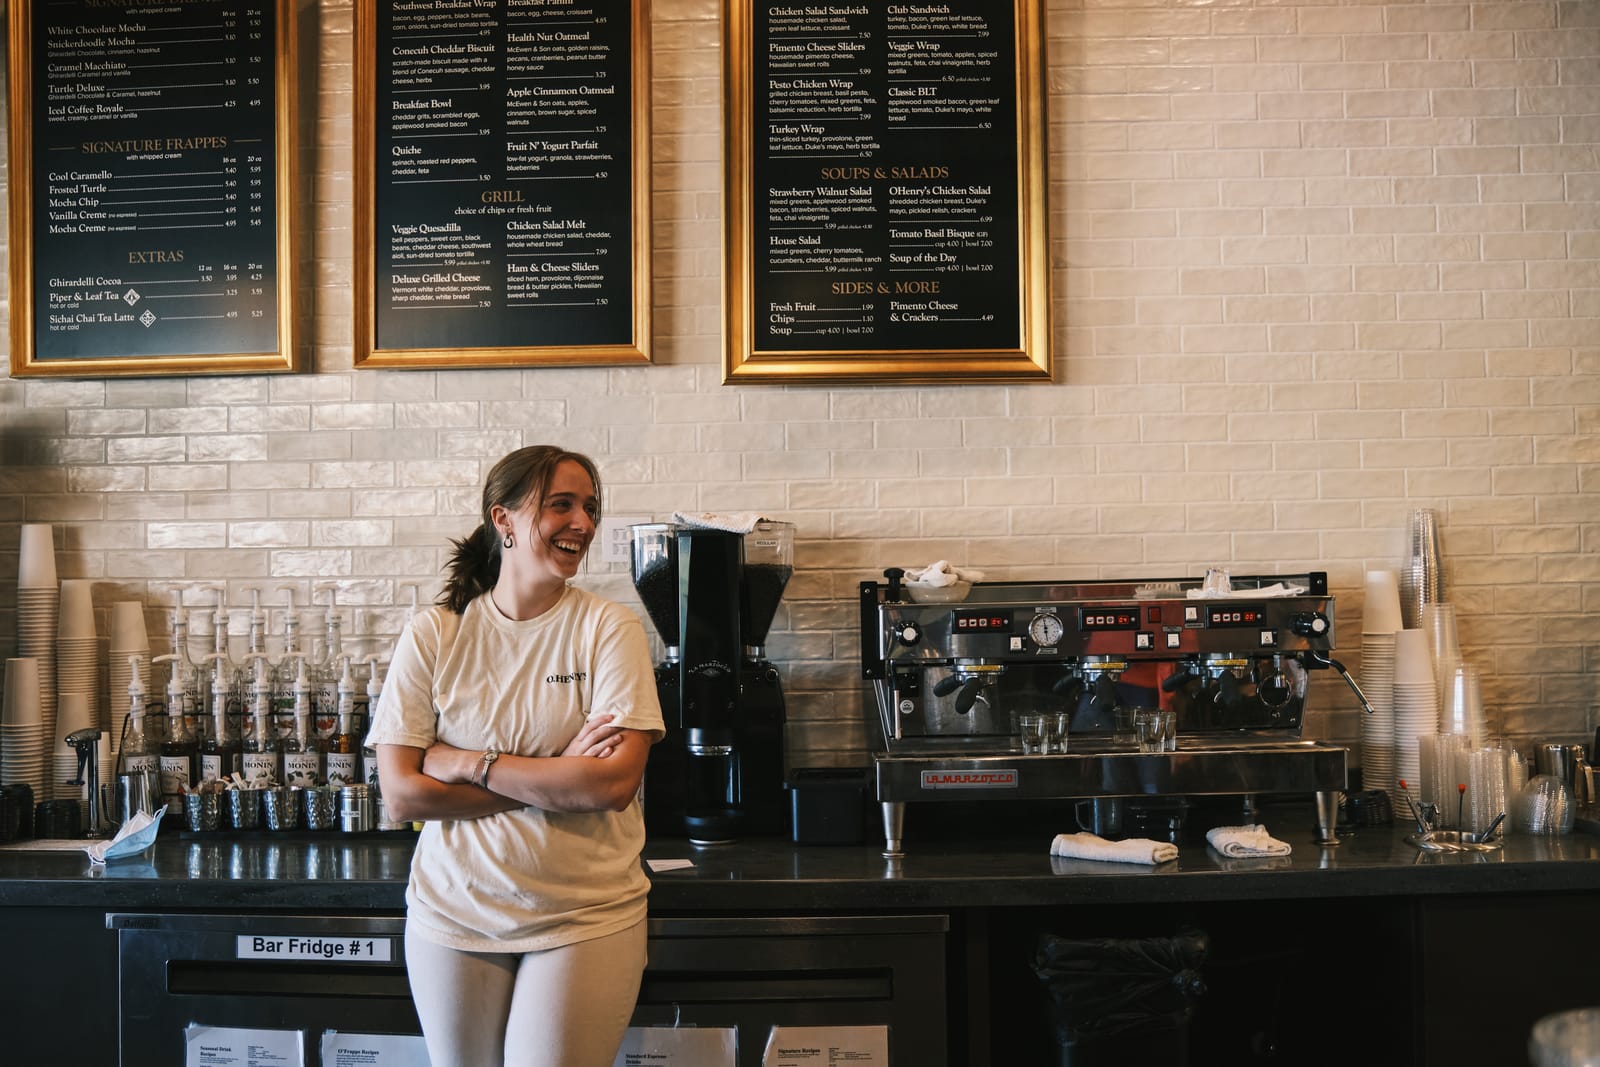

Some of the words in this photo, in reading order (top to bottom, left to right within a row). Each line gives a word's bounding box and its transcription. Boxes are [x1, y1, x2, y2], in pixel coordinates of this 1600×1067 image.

[393, 2, 433, 10] Southwest
[435, 0, 472, 8] Breakfast
[473, 0, 497, 8] Wrap
[887, 5, 909, 14] Club
[910, 5, 950, 14] Sandwich
[769, 7, 804, 16] Chicken
[805, 6, 827, 15] Salad
[829, 6, 869, 14] Sandwich
[75, 25, 116, 34] Chocolate
[118, 24, 146, 32] Mocha
[507, 33, 535, 42] Health
[537, 33, 553, 41] Nut
[554, 32, 590, 40] Oatmeal
[48, 38, 106, 48] Snickerdoodle
[108, 37, 136, 46] Mocha
[770, 44, 806, 52] Pimento
[806, 43, 836, 51] Cheese
[837, 42, 866, 51] Sliders
[888, 42, 915, 51] Veggie
[916, 41, 940, 51] Wrap
[392, 46, 429, 55] Conecuh
[430, 45, 466, 54] Cheddar
[467, 44, 495, 52] Biscuit
[48, 63, 82, 72] Caramel
[84, 61, 126, 70] Macchiato
[48, 84, 74, 93] Turtle
[76, 84, 105, 92] Deluxe
[769, 80, 792, 89] Pesto
[792, 80, 828, 88] Chicken
[829, 79, 854, 89] Wrap
[506, 88, 532, 97] Apple
[533, 87, 578, 95] Cinnamon
[579, 86, 614, 94] Oatmeal
[888, 88, 916, 96] Classic
[918, 87, 937, 96] BLT
[392, 100, 429, 109] Breakfast
[431, 99, 452, 108] Bowl
[49, 106, 65, 115] Iced
[67, 105, 94, 114] Coffee
[96, 104, 123, 114] Royale
[769, 125, 800, 134] Turkey
[801, 124, 825, 134] Wrap
[83, 140, 162, 153] SIGNATURE
[167, 137, 227, 150] FRAPPES
[507, 142, 527, 151] Fruit
[541, 141, 569, 151] Yogurt
[571, 141, 598, 149] Parfait
[392, 146, 422, 156] Quiche
[48, 172, 68, 181] Cool
[70, 170, 112, 180] Caramello
[821, 168, 870, 179] SOUPS
[874, 168, 887, 179] &
[892, 167, 949, 178] SALADS
[49, 185, 79, 194] Frosted
[80, 184, 107, 193] Turtle
[769, 188, 815, 196] Strawberry
[816, 187, 848, 196] Walnut
[850, 187, 872, 195] Salad
[932, 186, 967, 195] Chicken
[968, 186, 991, 194] Salad
[481, 191, 525, 202] GRILL
[49, 198, 77, 207] Mocha
[78, 197, 99, 207] Chip
[454, 207, 477, 215] choice
[478, 206, 486, 214] of
[487, 206, 506, 215] chips
[517, 205, 534, 213] fresh
[49, 211, 78, 220] Vanilla
[79, 211, 107, 219] Creme
[49, 224, 77, 233] Mocha
[78, 224, 106, 232] Creme
[392, 225, 418, 234] Veggie
[419, 223, 461, 234] Quesadilla
[506, 221, 541, 230] Chicken
[542, 220, 564, 229] Salad
[566, 220, 586, 229] Melt
[889, 229, 923, 238] Tomato
[924, 229, 944, 238] Basil
[946, 229, 975, 239] Bisque
[770, 236, 797, 245] House
[798, 236, 821, 244] Salad
[129, 251, 184, 263] EXTRAS
[890, 254, 912, 264] Soup
[913, 253, 922, 262] of
[924, 253, 938, 262] the
[940, 253, 957, 262] Day
[507, 264, 528, 272] Ham
[530, 264, 539, 272] &
[541, 263, 570, 272] Cheese
[571, 262, 599, 271] Sliders
[49, 277, 94, 287] Ghirardelli
[96, 277, 122, 286] Cocoa
[392, 275, 421, 284] Deluxe
[422, 274, 451, 283] Grilled
[452, 273, 480, 282] Cheese
[832, 282, 873, 294] SIDES
[877, 282, 890, 294] &
[896, 282, 939, 293] MORE
[50, 293, 72, 303] Piper
[74, 293, 83, 302] &
[85, 291, 103, 300] Leaf
[104, 291, 119, 300] Tea
[770, 302, 793, 311] Fresh
[795, 302, 816, 311] Fruit
[890, 301, 927, 310] Pimento
[928, 301, 958, 310] Cheese
[50, 314, 74, 323] Sichai
[76, 314, 95, 322] Chai
[97, 313, 112, 322] Tea
[114, 313, 135, 322] Latte
[770, 314, 795, 324] Chips
[890, 313, 900, 322] &
[902, 313, 939, 321] Crackers
[770, 326, 792, 335] Soup
[288, 761, 317, 769] MONIN
[328, 761, 352, 769] ONIN
[926, 774, 939, 784] LA
[943, 773, 1014, 784] MARZOCCO
[253, 937, 283, 953] Bar
[289, 938, 344, 958] Fridge
[349, 940, 361, 955] #
[366, 941, 374, 956] 1
